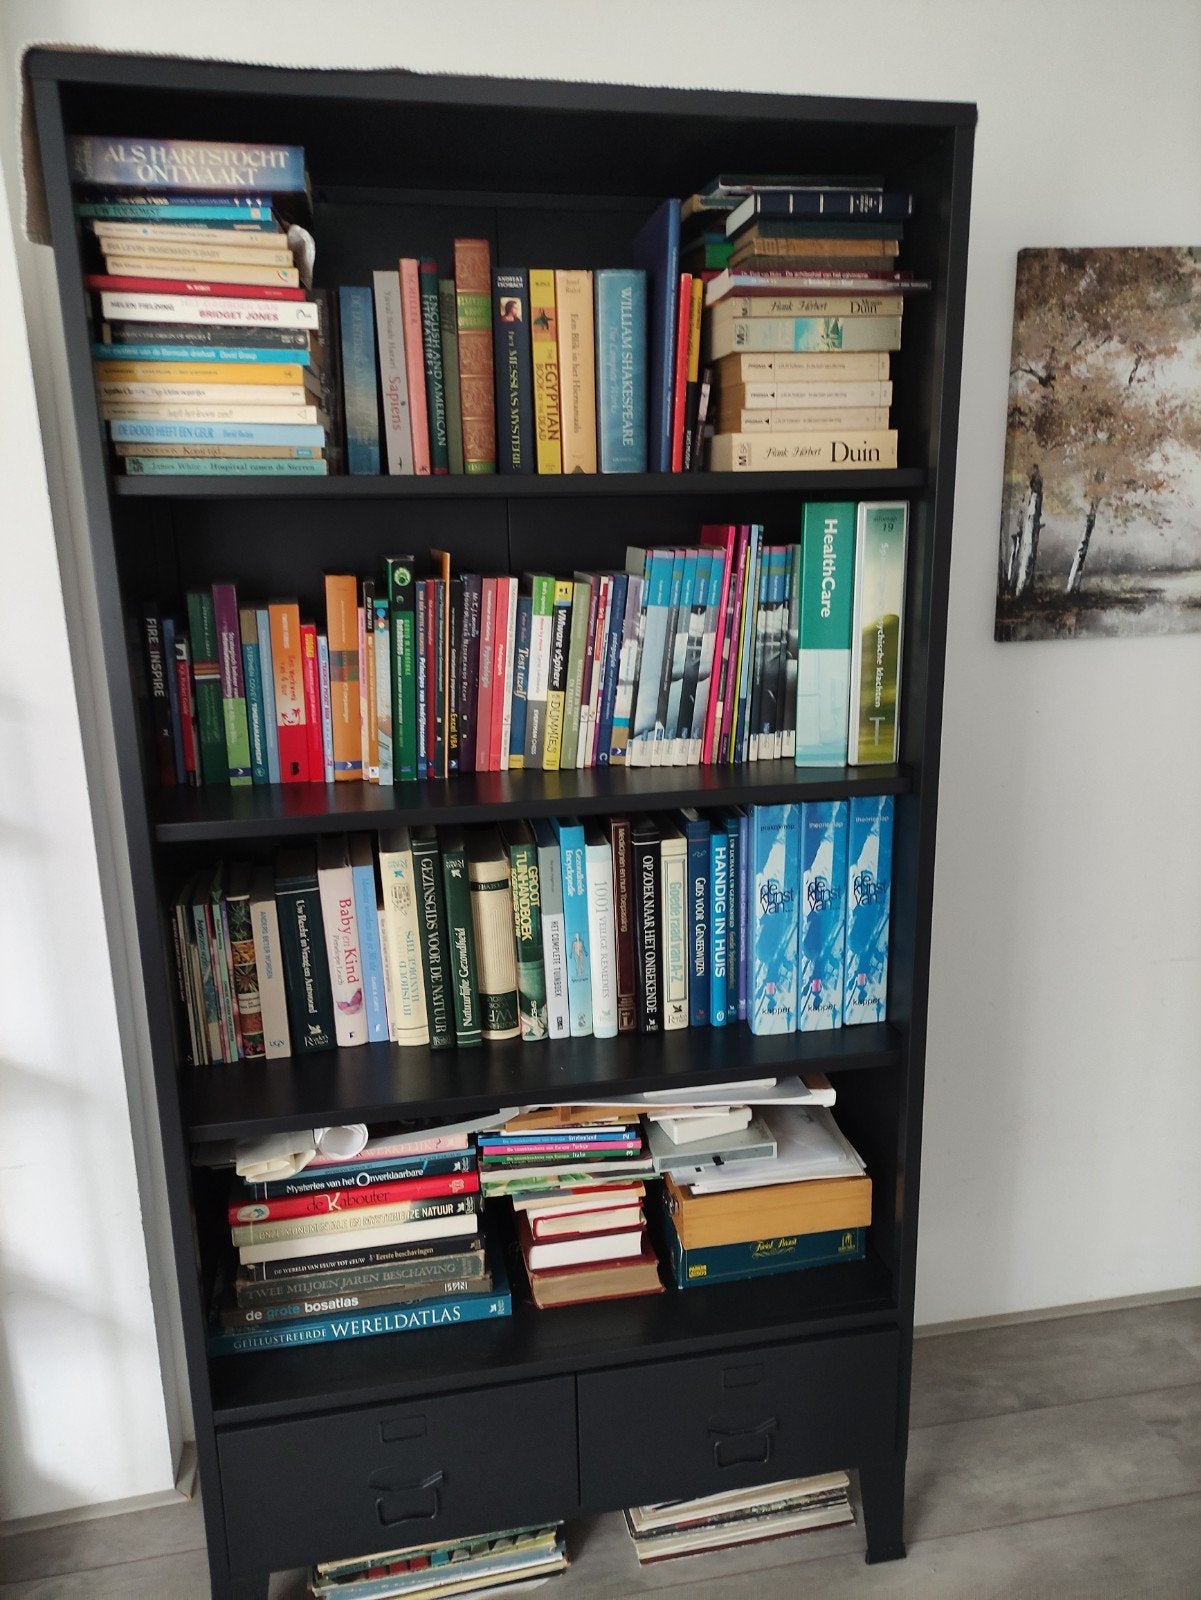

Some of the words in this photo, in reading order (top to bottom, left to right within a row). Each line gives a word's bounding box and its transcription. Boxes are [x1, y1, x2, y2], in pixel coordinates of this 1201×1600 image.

[105, 143, 147, 164] ALS
[148, 146, 290, 168] HARTSTOCHT
[136, 164, 258, 186] ONTWAAKT
[199, 309, 242, 319] BRIDGET
[245, 311, 280, 322] JONES
[428, 294, 440, 349] ENGLISH
[620, 286, 632, 349] WILLIAM
[850, 301, 878, 314] Duin
[571, 333, 581, 351] Blik
[432, 351, 443, 380] AND
[535, 362, 546, 391] BOOK
[572, 363, 581, 378] het
[386, 375, 403, 432] Sapiens
[545, 362, 560, 441] EGYPTIAN
[621, 352, 634, 447] SHAKESPEARE
[434, 382, 446, 447] AMERICAN
[538, 415, 547, 441] DEAD
[767, 447, 789, 459] Frank
[792, 447, 822, 458] Herbert
[831, 441, 881, 463] Duin
[882, 523, 894, 533] 19
[820, 518, 839, 619] HealthCare
[145, 617, 159, 644] FIRE
[555, 608, 567, 648] VMware
[418, 656, 426, 688] Principes
[481, 645, 491, 688] Psychologie
[516, 647, 529, 670] Test
[552, 649, 564, 688] vSphere
[149, 650, 165, 697] INSPIRE
[514, 672, 527, 701] uzelf
[874, 666, 885, 708] klachten
[450, 712, 458, 732] Excel
[531, 708, 539, 739] EVERYMAN
[548, 701, 561, 754] DUMMIES
[450, 733, 458, 749] VBA
[618, 828, 627, 867] Medicijnen
[565, 850, 576, 897] Encyclopedie
[575, 848, 584, 896] Gezondheids
[620, 868, 627, 878] en
[643, 855, 655, 870] OP
[528, 865, 540, 907] GROOT
[643, 870, 655, 899] ZOEK
[695, 877, 707, 897] GIDS
[714, 846, 726, 914] HANDIG
[760, 879, 778, 896] de
[807, 877, 826, 895] de
[853, 879, 888, 896] kunst
[854, 870, 871, 887] de
[420, 857, 438, 930] GEZINSGIDS
[516, 851, 533, 941] TUINHANDBOEK
[594, 879, 609, 914] 1001
[669, 881, 682, 916] Goede
[760, 888, 795, 905] kunst
[807, 885, 842, 902] kunst
[260, 911, 269, 935] ANDERS
[338, 899, 354, 935] Baby
[619, 894, 629, 933] Toepassing
[644, 899, 655, 929] NAAR
[714, 917, 726, 934] IN
[599, 916, 608, 952] VEILIGE
[644, 929, 656, 950] HET
[670, 917, 682, 942] raad
[262, 935, 271, 954] BETER
[429, 932, 441, 964] VOOR
[454, 927, 469, 979] Gezondheid
[551, 933, 561, 965] COMPLETE
[669, 943, 681, 963] van
[714, 938, 726, 978] HUIS
[264, 955, 273, 980] WORDEN
[297, 914, 309, 938] Recht
[305, 978, 318, 1013] Antwoord
[345, 948, 359, 984] Kind
[430, 966, 442, 983] DE
[600, 953, 610, 999] REMEDIES
[670, 964, 684, 982] A-Z
[553, 967, 563, 998] TUINBOEK
[645, 951, 658, 1014] ONBEKENDE
[432, 984, 448, 1033] NATUUR
[458, 979, 473, 1027] Natuurlijke
[761, 1006, 792, 1017] kapper
[807, 1003, 837, 1013] kapper
[852, 996, 881, 1007] kapper
[286, 1181, 325, 1195] Mysteries
[325, 1180, 341, 1189] van
[342, 1177, 356, 1187] het
[356, 1167, 424, 1187] Onverklaarbare
[305, 1195, 323, 1212] de
[316, 1190, 390, 1211] Kabouter
[421, 1203, 454, 1218] NATUUR
[282, 1264, 307, 1274] WERELD
[307, 1263, 319, 1271] VAN
[336, 1259, 348, 1267] TOT
[348, 1257, 366, 1265] EEUW
[394, 1247, 434, 1260] beschavingen
[247, 1284, 285, 1300] TWEE
[286, 1279, 339, 1295] MILJOEN
[341, 1273, 380, 1290] JAREN
[382, 1263, 457, 1281] BESCHAVING
[245, 1310, 263, 1321] de
[265, 1303, 301, 1321] grote
[304, 1296, 359, 1313] bosatlas
[330, 1305, 461, 1338] WERELDATLAS
